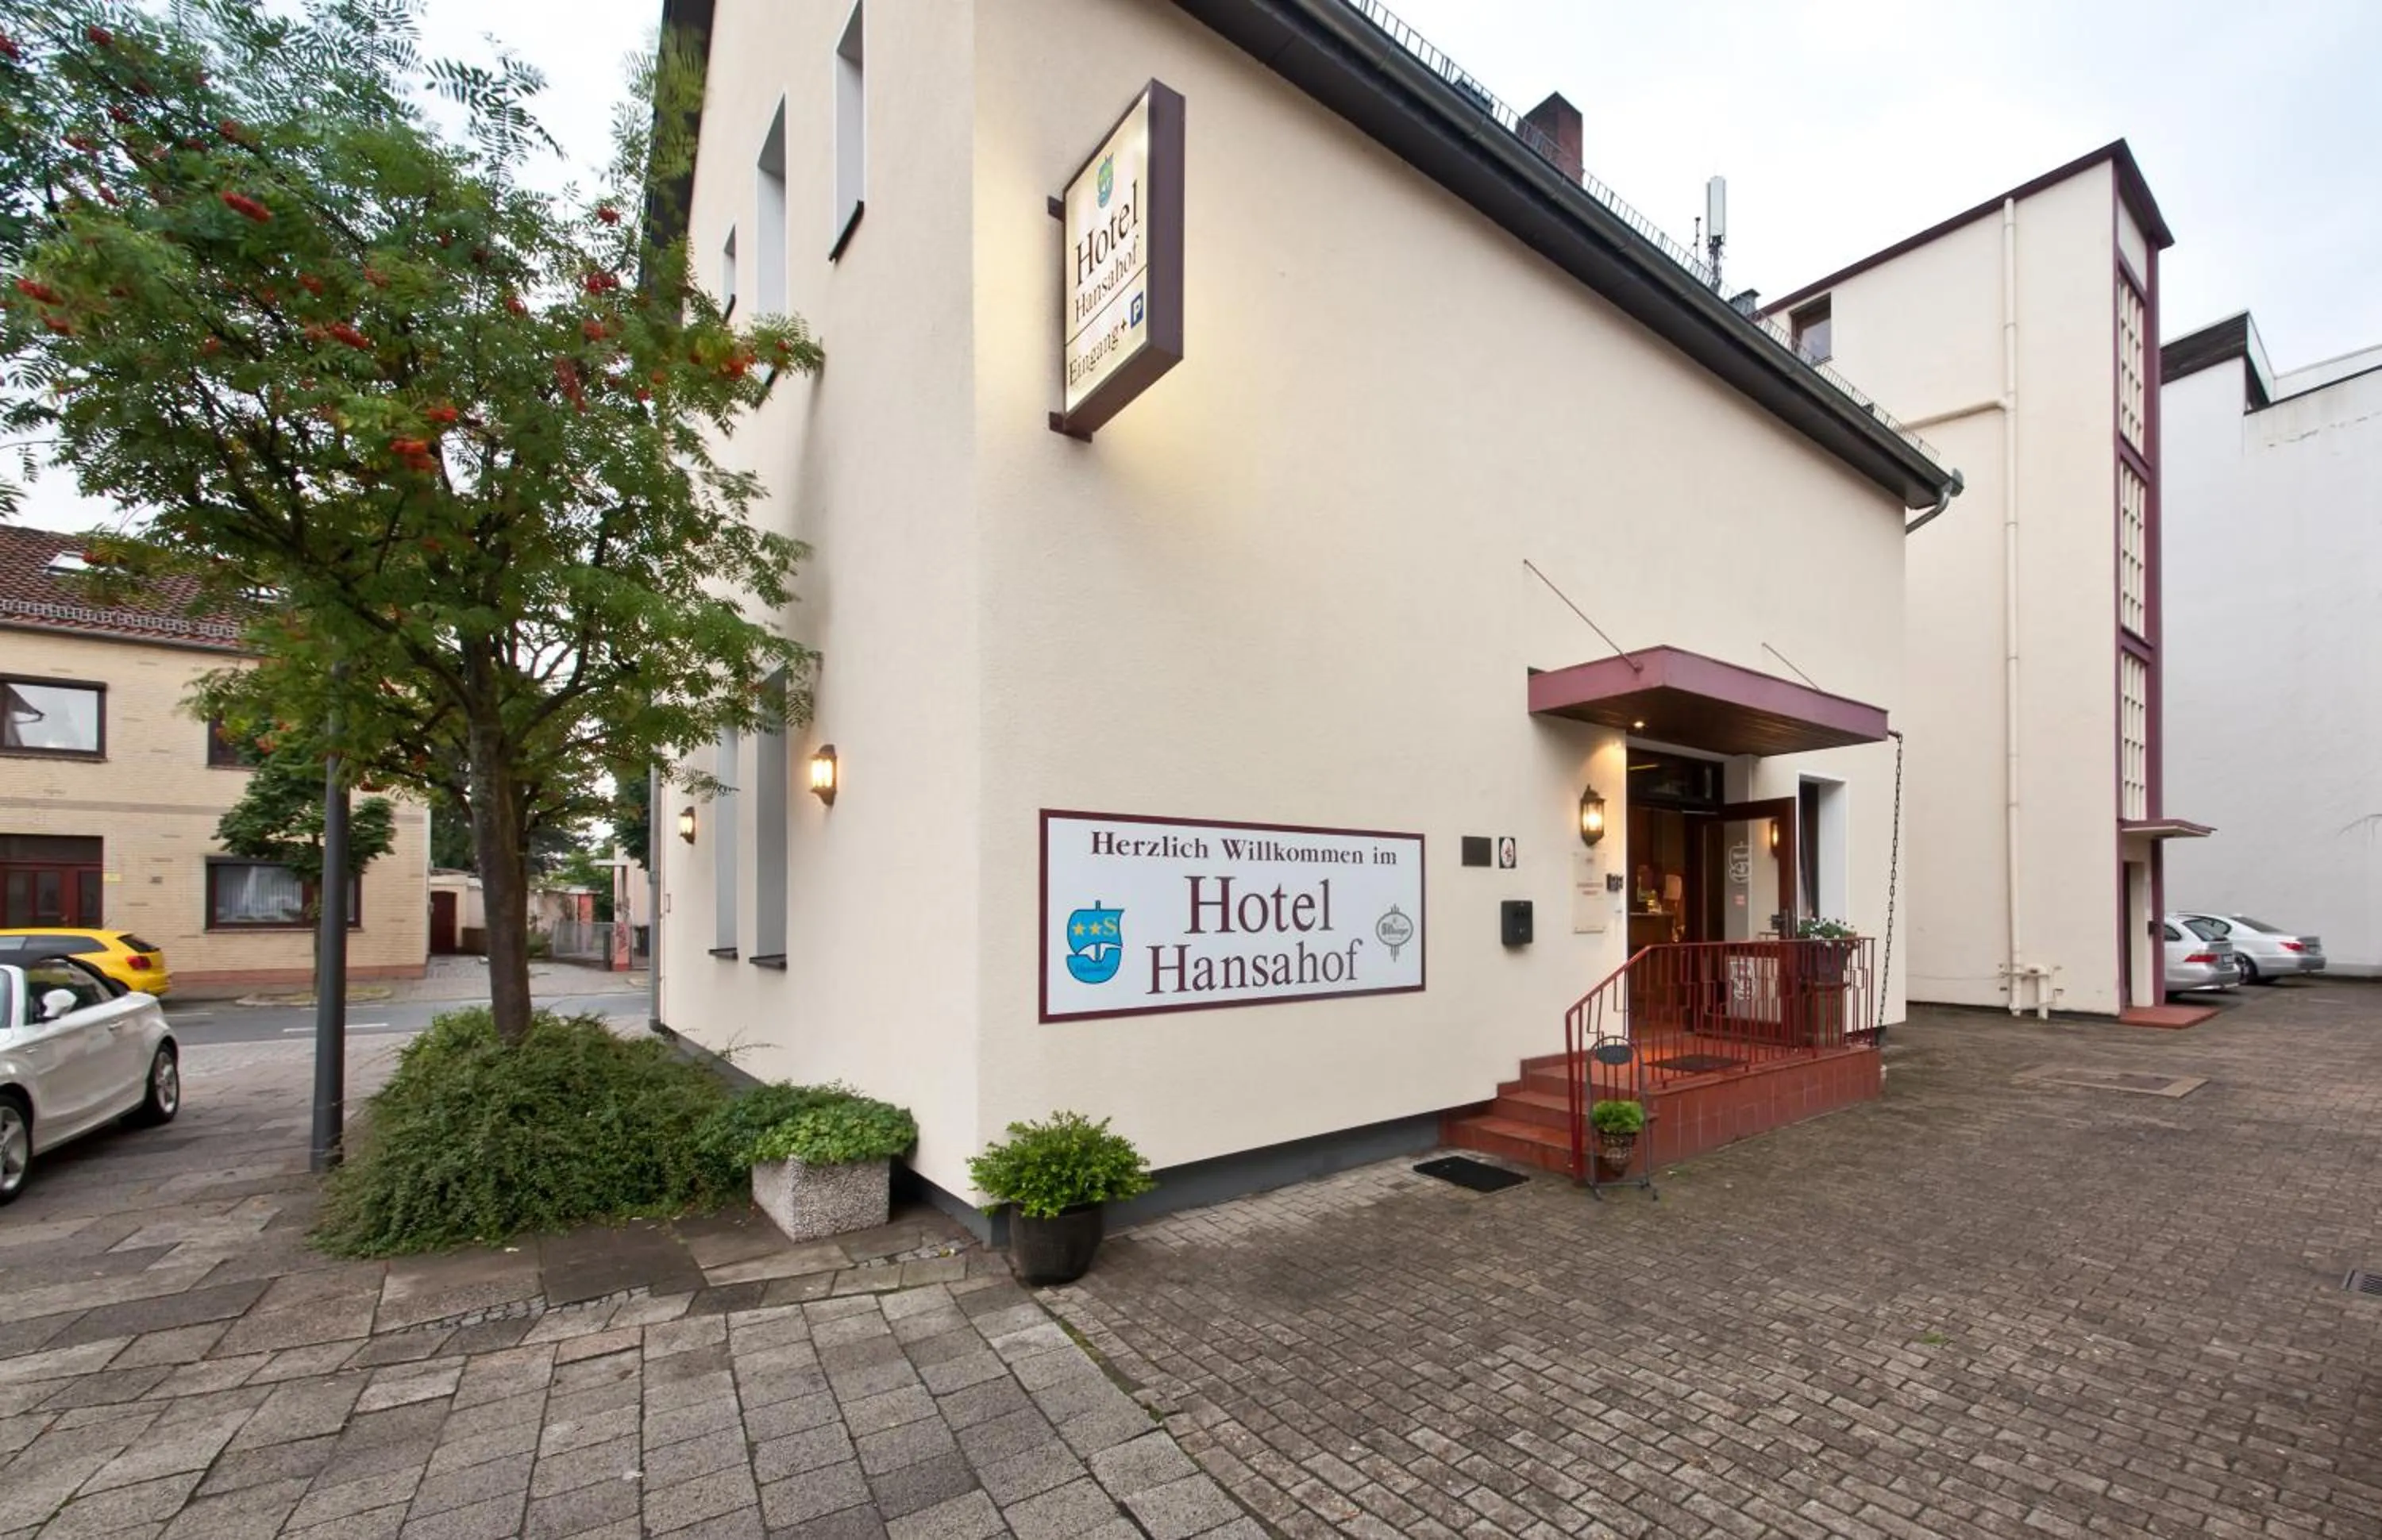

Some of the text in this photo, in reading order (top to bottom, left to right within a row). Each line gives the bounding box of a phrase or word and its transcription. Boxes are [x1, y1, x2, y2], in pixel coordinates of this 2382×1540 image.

[1075, 179, 1139, 288] Hotel
[1075, 233, 1139, 323] Hansahof
[1069, 325, 1119, 386] Eingang
[1132, 296, 1143, 325] P
[1091, 831, 1397, 865] Herzlich Willkommen im
[1184, 875, 1334, 934] Hotel
[1145, 937, 1364, 995] Hansahof
